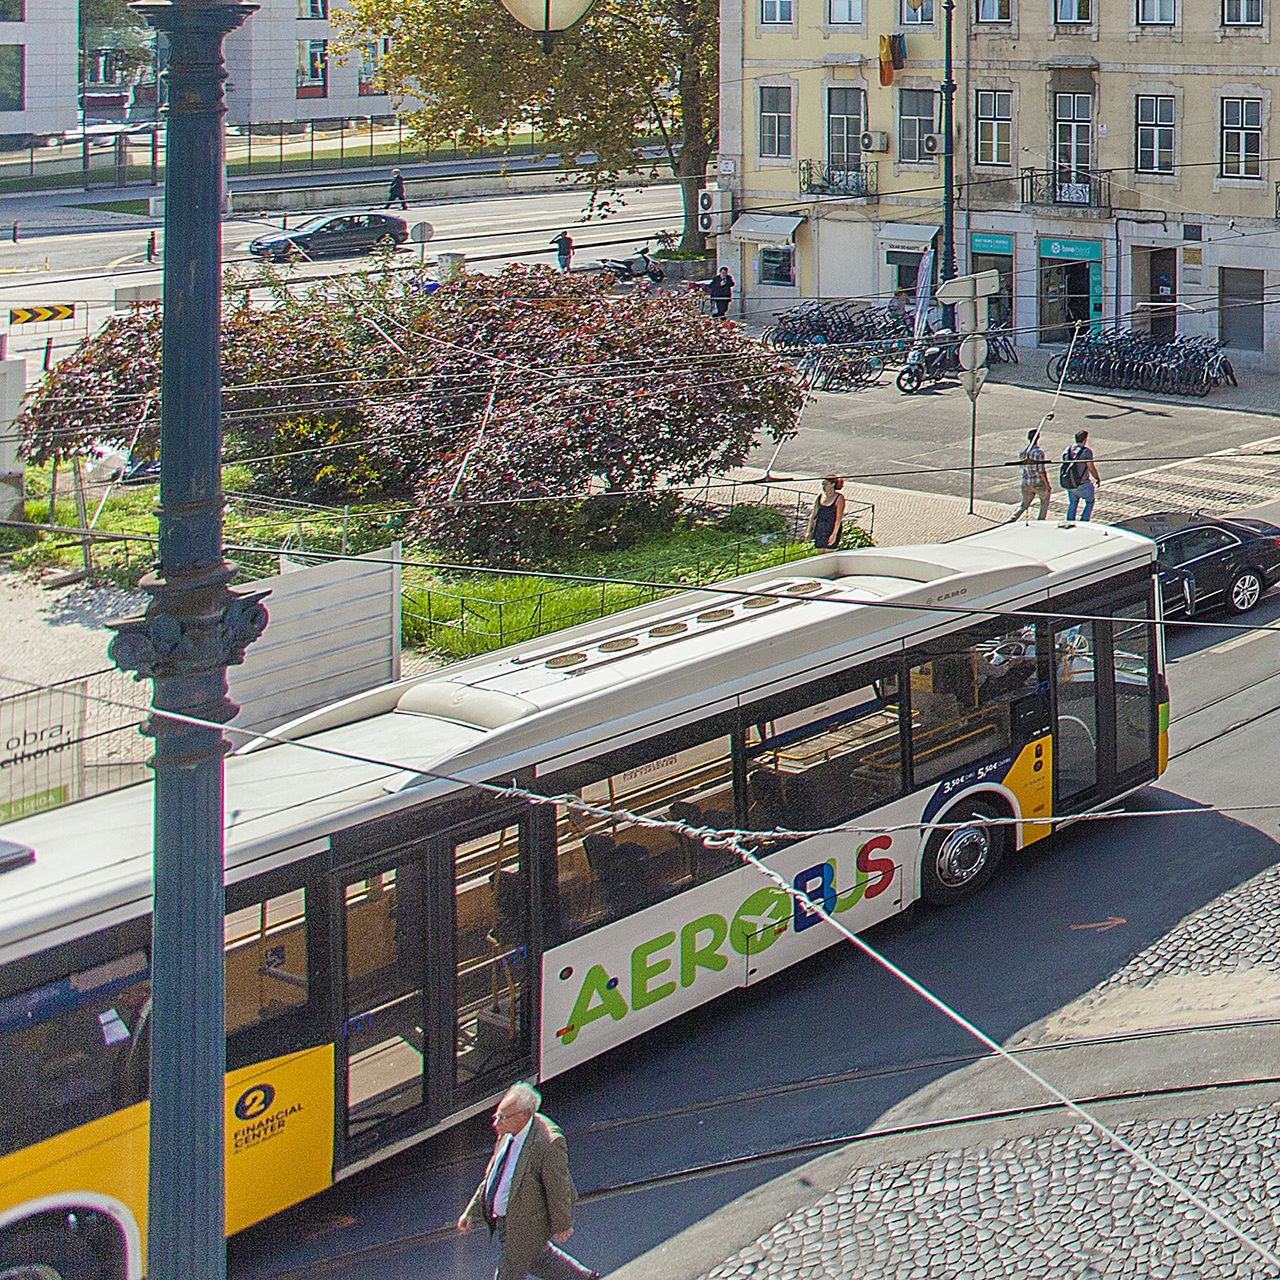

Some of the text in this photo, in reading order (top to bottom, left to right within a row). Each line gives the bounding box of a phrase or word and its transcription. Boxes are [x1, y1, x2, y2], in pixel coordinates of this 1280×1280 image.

[937, 588, 968, 602] CAMO
[6, 723, 71, 751] obra,
[562, 835, 895, 1046] AEROBUS
[234, 1103, 304, 1140] FINANCIAL
[234, 1121, 286, 1150] CENTER
